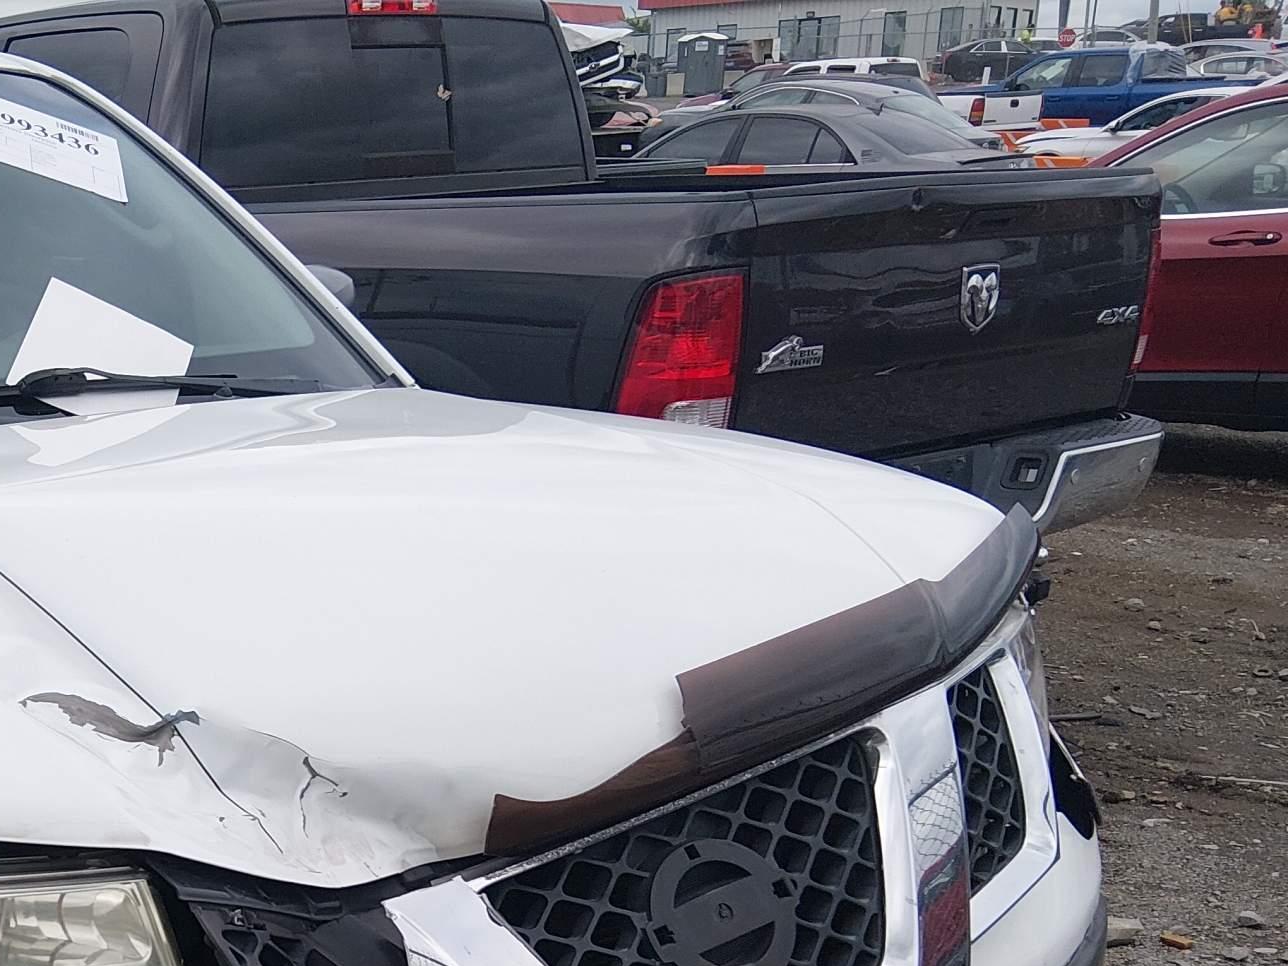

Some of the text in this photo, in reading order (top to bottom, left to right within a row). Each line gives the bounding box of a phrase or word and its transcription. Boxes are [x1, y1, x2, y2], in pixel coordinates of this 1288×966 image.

[1059, 33, 1076, 42] STOP
[799, 349, 819, 357] BIG
[791, 357, 821, 366] HORN
